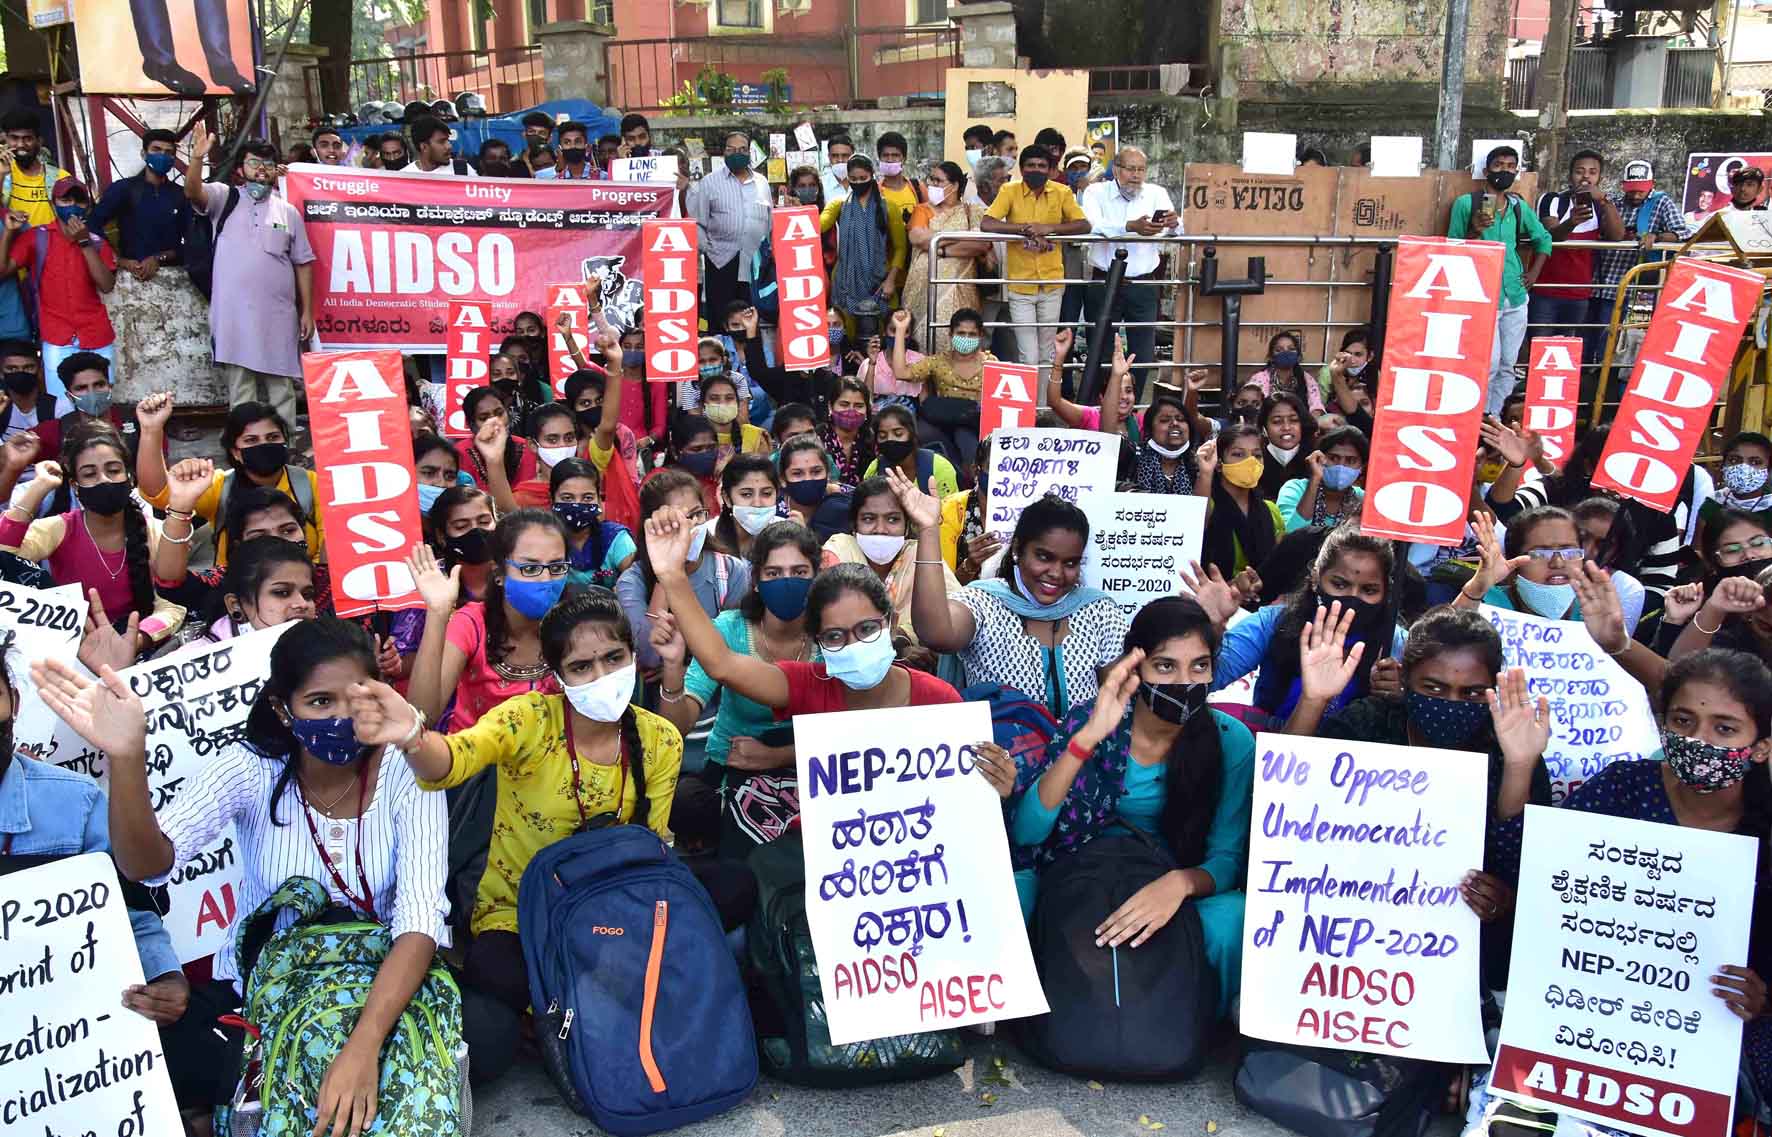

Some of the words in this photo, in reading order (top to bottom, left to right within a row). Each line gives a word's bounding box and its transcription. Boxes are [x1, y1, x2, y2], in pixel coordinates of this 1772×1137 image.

[629, 159, 657, 170] LONG
[313, 176, 379, 194] Struggle
[465, 184, 512, 201] Unity
[592, 188, 657, 204] Progress
[1231, 184, 1304, 211] DELTA
[329, 231, 517, 296] AIDSO
[781, 214, 828, 359] AIDSO
[323, 298, 336, 307] All
[339, 298, 363, 307] India
[366, 299, 417, 308] Democratic
[648, 227, 697, 373] AIDSO
[1374, 254, 1492, 527] AIDSO
[1604, 275, 1740, 494] AIDSO
[999, 436, 1030, 450] ಕಲಾ
[1037, 437, 1101, 455] ವಿಭಾಗದ
[320, 359, 417, 600] AIDSO
[992, 477, 1038, 498] ಮೇಲೆ
[1094, 530, 1137, 551] ಶೈಕ್ಷಣಿಕ
[1140, 533, 1184, 546] ವರ್ಷದ
[1115, 507, 1168, 529] ಸಂಕಷ್ಟದ
[1101, 554, 1175, 575] ಸಂದರ್ಭದಲ್ಲಿ
[1102, 578, 1171, 592] NEP-2020
[808, 743, 978, 799] NEP-2020
[1262, 750, 1311, 786] We
[1330, 752, 1430, 807] Oppose
[832, 796, 936, 850] ಹಠಾತ್
[1262, 802, 1447, 848] Undemocratic
[819, 843, 949, 901] ಹೇರಿಕೆಗೆ
[1587, 839, 1683, 881] ಸಂಕಷ್ಟದ
[1257, 860, 1459, 914] Implementation
[1551, 869, 1628, 906] ಶೈಕ್ಷಣಿಕ
[1634, 886, 1717, 919] ವರ್ಷದ
[71, 921, 99, 974] of
[592, 926, 624, 937] FOGO
[1253, 910, 1285, 947] of
[1299, 913, 1460, 958] NEP-2020
[1560, 910, 1700, 965] ಸಂದರ್ಭದಲ್ಲಿ
[834, 952, 918, 1001] AIDSO
[920, 974, 1006, 1022] AISEC
[1300, 961, 1415, 1007] AIDSO
[1561, 948, 1691, 992] NEP-2020
[1296, 1008, 1412, 1049] AISEC
[1544, 984, 1624, 1016] ಧಿಡೀರ್
[1630, 1000, 1702, 1034] ಹೇರಿಕೆ
[1555, 1024, 1677, 1069] ವಿರೋಧಿಸಿ!
[118, 1090, 146, 1137] of
[1523, 1060, 1696, 1126] AIDSO
